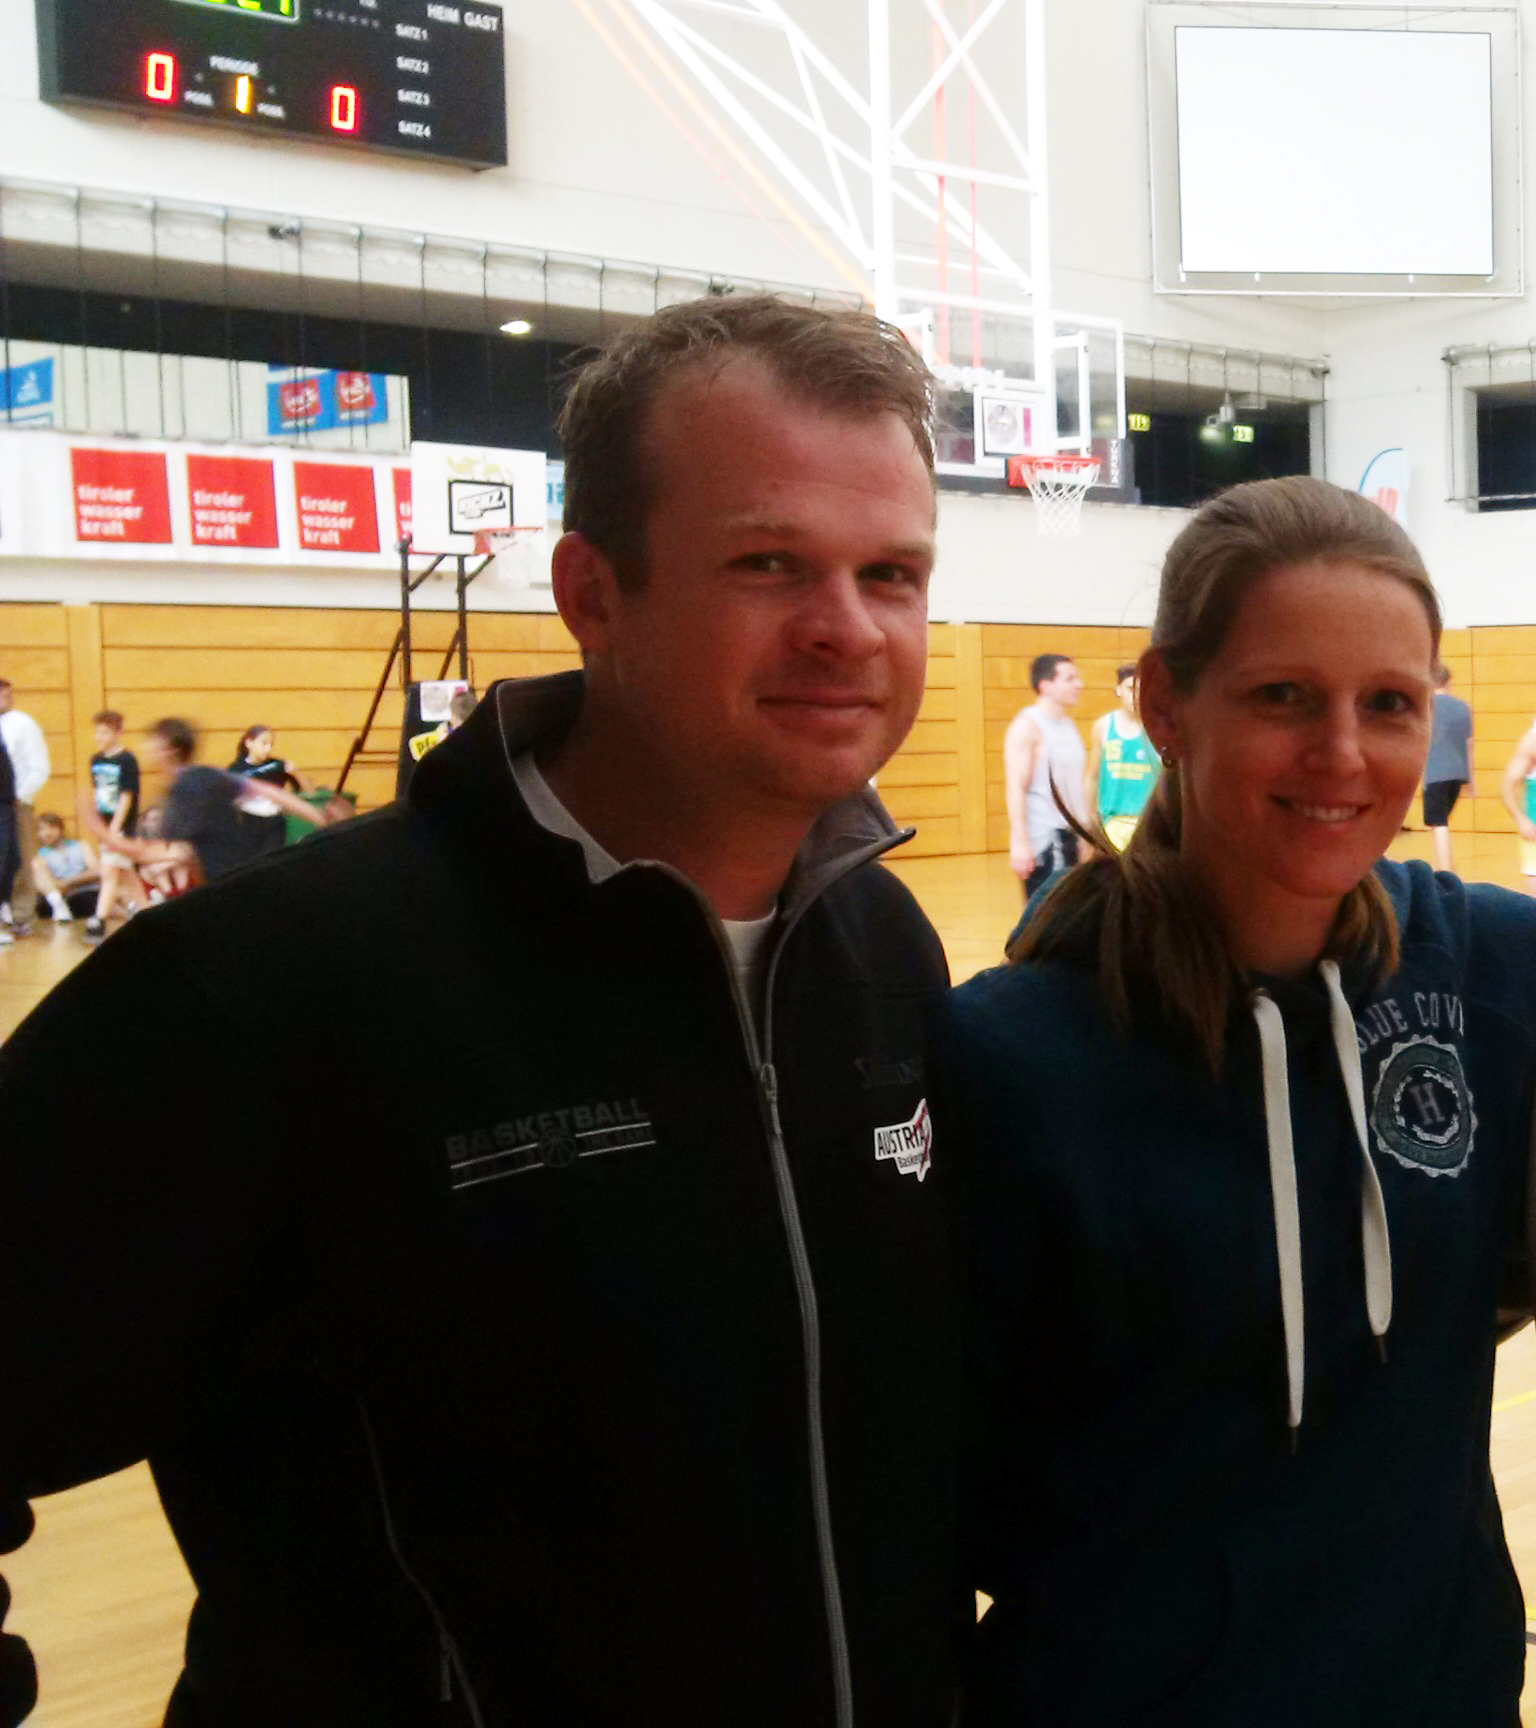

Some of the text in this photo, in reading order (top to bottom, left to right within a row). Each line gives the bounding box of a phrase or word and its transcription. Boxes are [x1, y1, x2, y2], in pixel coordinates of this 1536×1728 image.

[427, 4, 499, 32] HEIM GAST
[146, 52, 175, 100] 0
[235, 74, 250, 114] 1
[330, 86, 356, 130] 0
[301, 496, 347, 512] tiroler
[301, 513, 354, 529] wasser
[303, 528, 340, 545] kraft
[444, 1098, 649, 1160] BASKETBALL
